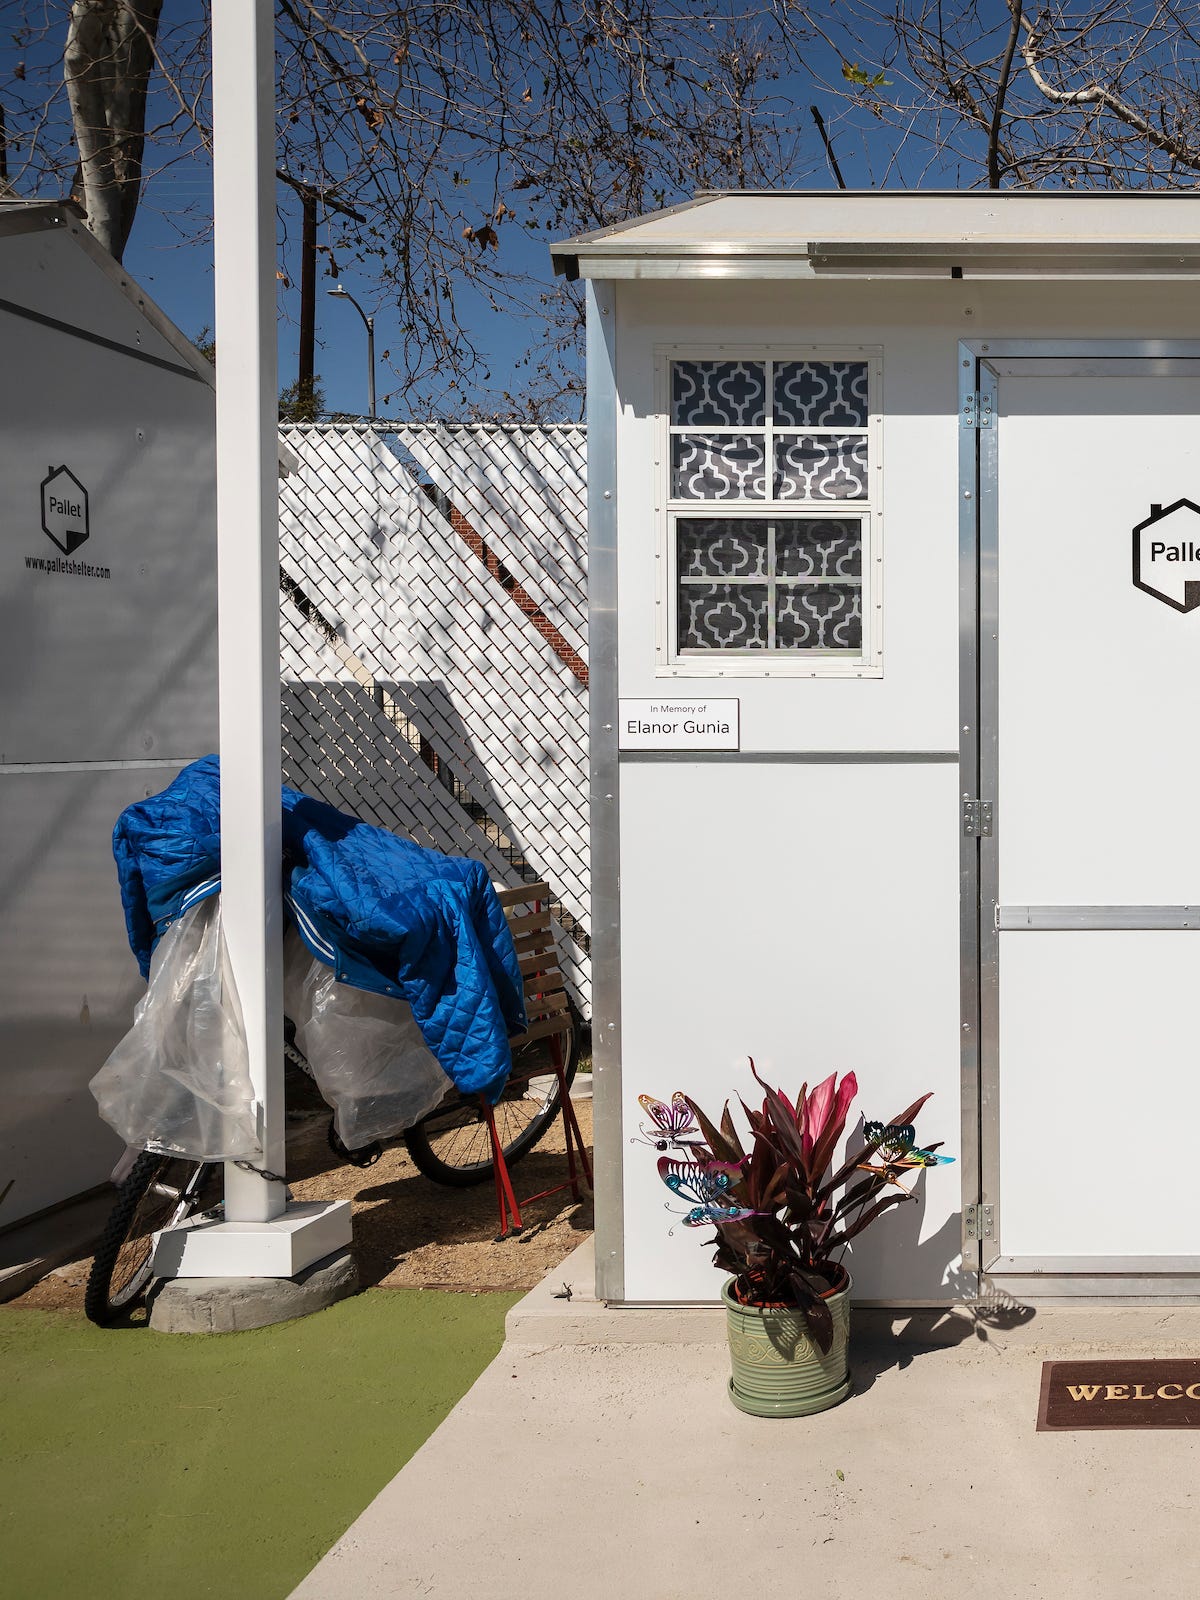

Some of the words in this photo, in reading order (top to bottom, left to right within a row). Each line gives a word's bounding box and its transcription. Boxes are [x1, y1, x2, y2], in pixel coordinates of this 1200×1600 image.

[49, 496, 81, 518] Pallet
[25, 556, 111, 579] www.palletshelter.com
[650, 705, 659, 713] In
[660, 705, 696, 715] Memory
[697, 705, 707, 713] of
[627, 720, 679, 734] Elanor
[683, 720, 730, 734] Gunia
